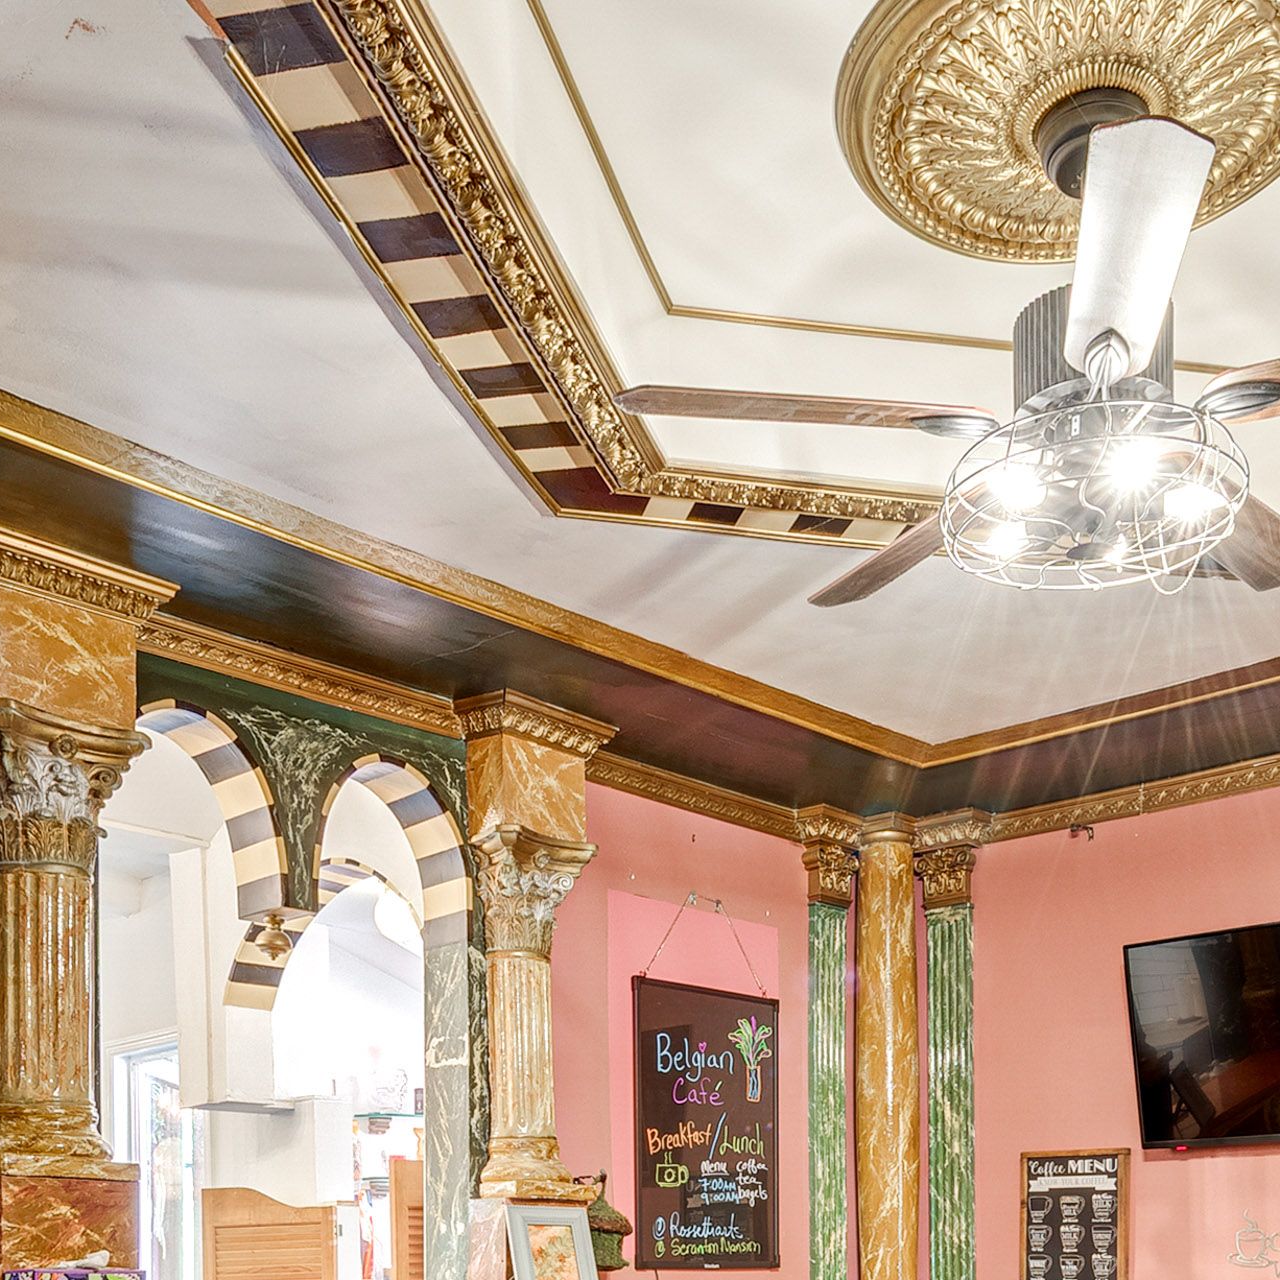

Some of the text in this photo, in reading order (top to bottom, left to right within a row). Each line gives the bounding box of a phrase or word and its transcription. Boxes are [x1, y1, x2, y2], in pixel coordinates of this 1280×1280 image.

[656, 1032, 734, 1083] Belgian
[672, 1077, 725, 1106] Café
[736, 1158, 769, 1175] coffee
[1028, 1158, 1118, 1178] Coffee MENU
[735, 1173, 763, 1186] tea
